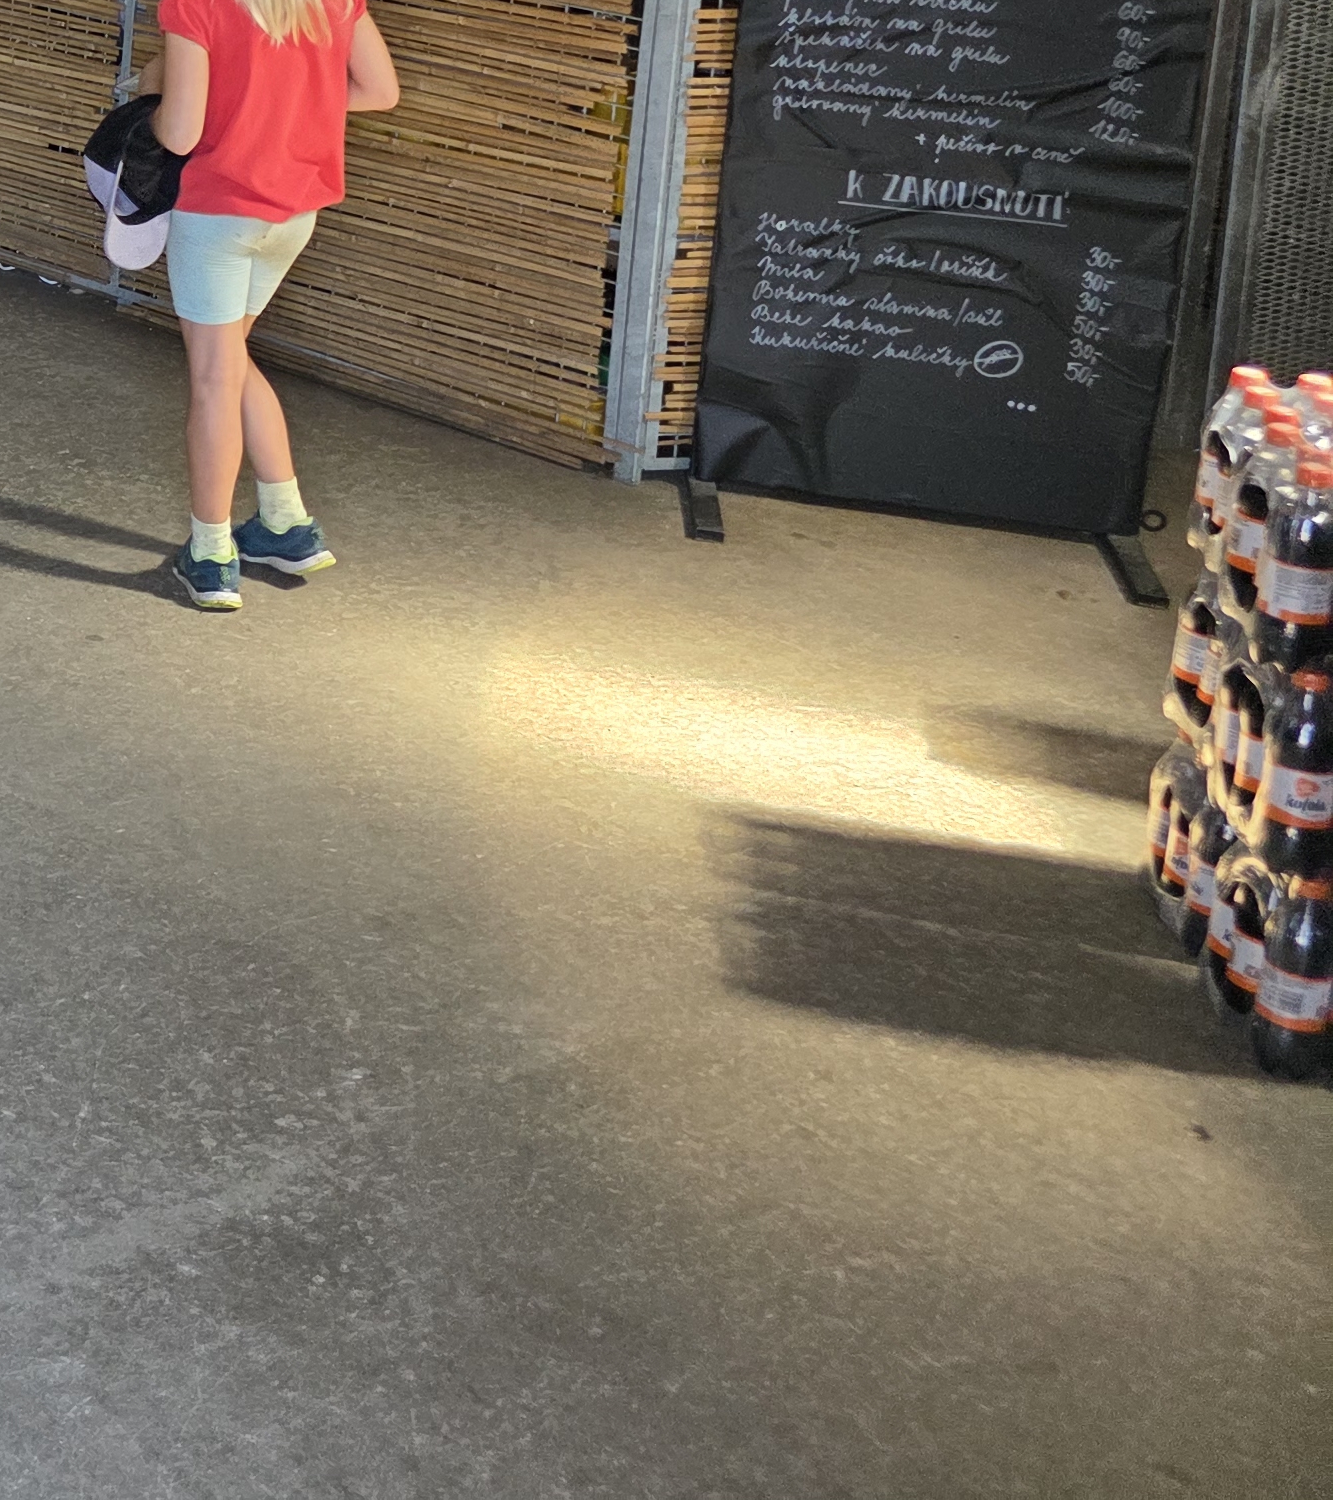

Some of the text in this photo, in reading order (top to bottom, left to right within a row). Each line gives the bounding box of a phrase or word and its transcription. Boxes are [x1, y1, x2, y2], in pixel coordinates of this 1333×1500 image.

[887, 17, 999, 45] na grilu
[904, 41, 944, 58] na
[950, 45, 1012, 72] grilu
[772, 75, 922, 102] nakládaný
[923, 83, 1038, 113] hermelín
[771, 94, 879, 127] grilovaný
[882, 102, 1002, 130] hermelín
[846, 169, 864, 200] K
[757, 211, 861, 248] Horalky
[752, 279, 855, 309] Bohemia
[872, 346, 973, 378] kuličky
